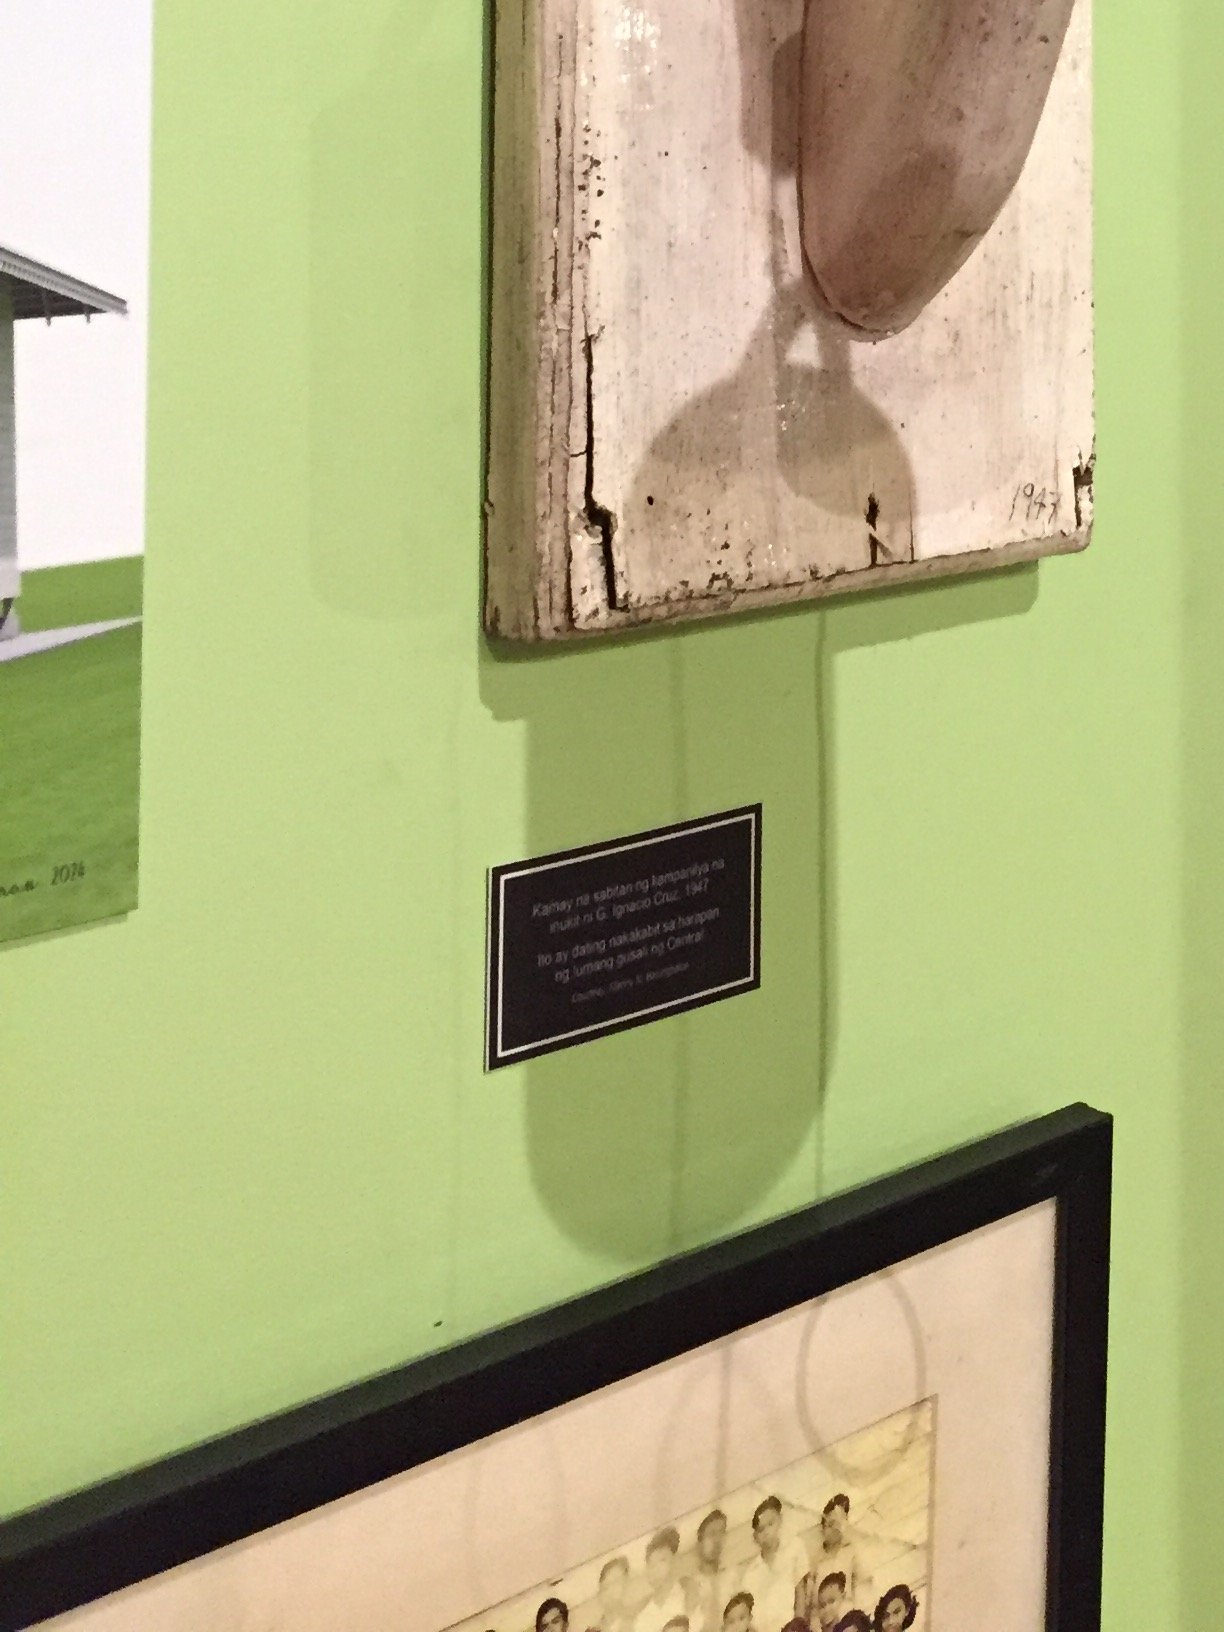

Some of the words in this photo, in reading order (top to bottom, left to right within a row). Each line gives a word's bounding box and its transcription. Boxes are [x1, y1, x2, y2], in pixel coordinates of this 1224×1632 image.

[1008, 482, 1062, 525] 1947
[575, 893, 589, 906] na
[634, 878, 649, 892] ng
[554, 950, 568, 962] ay
